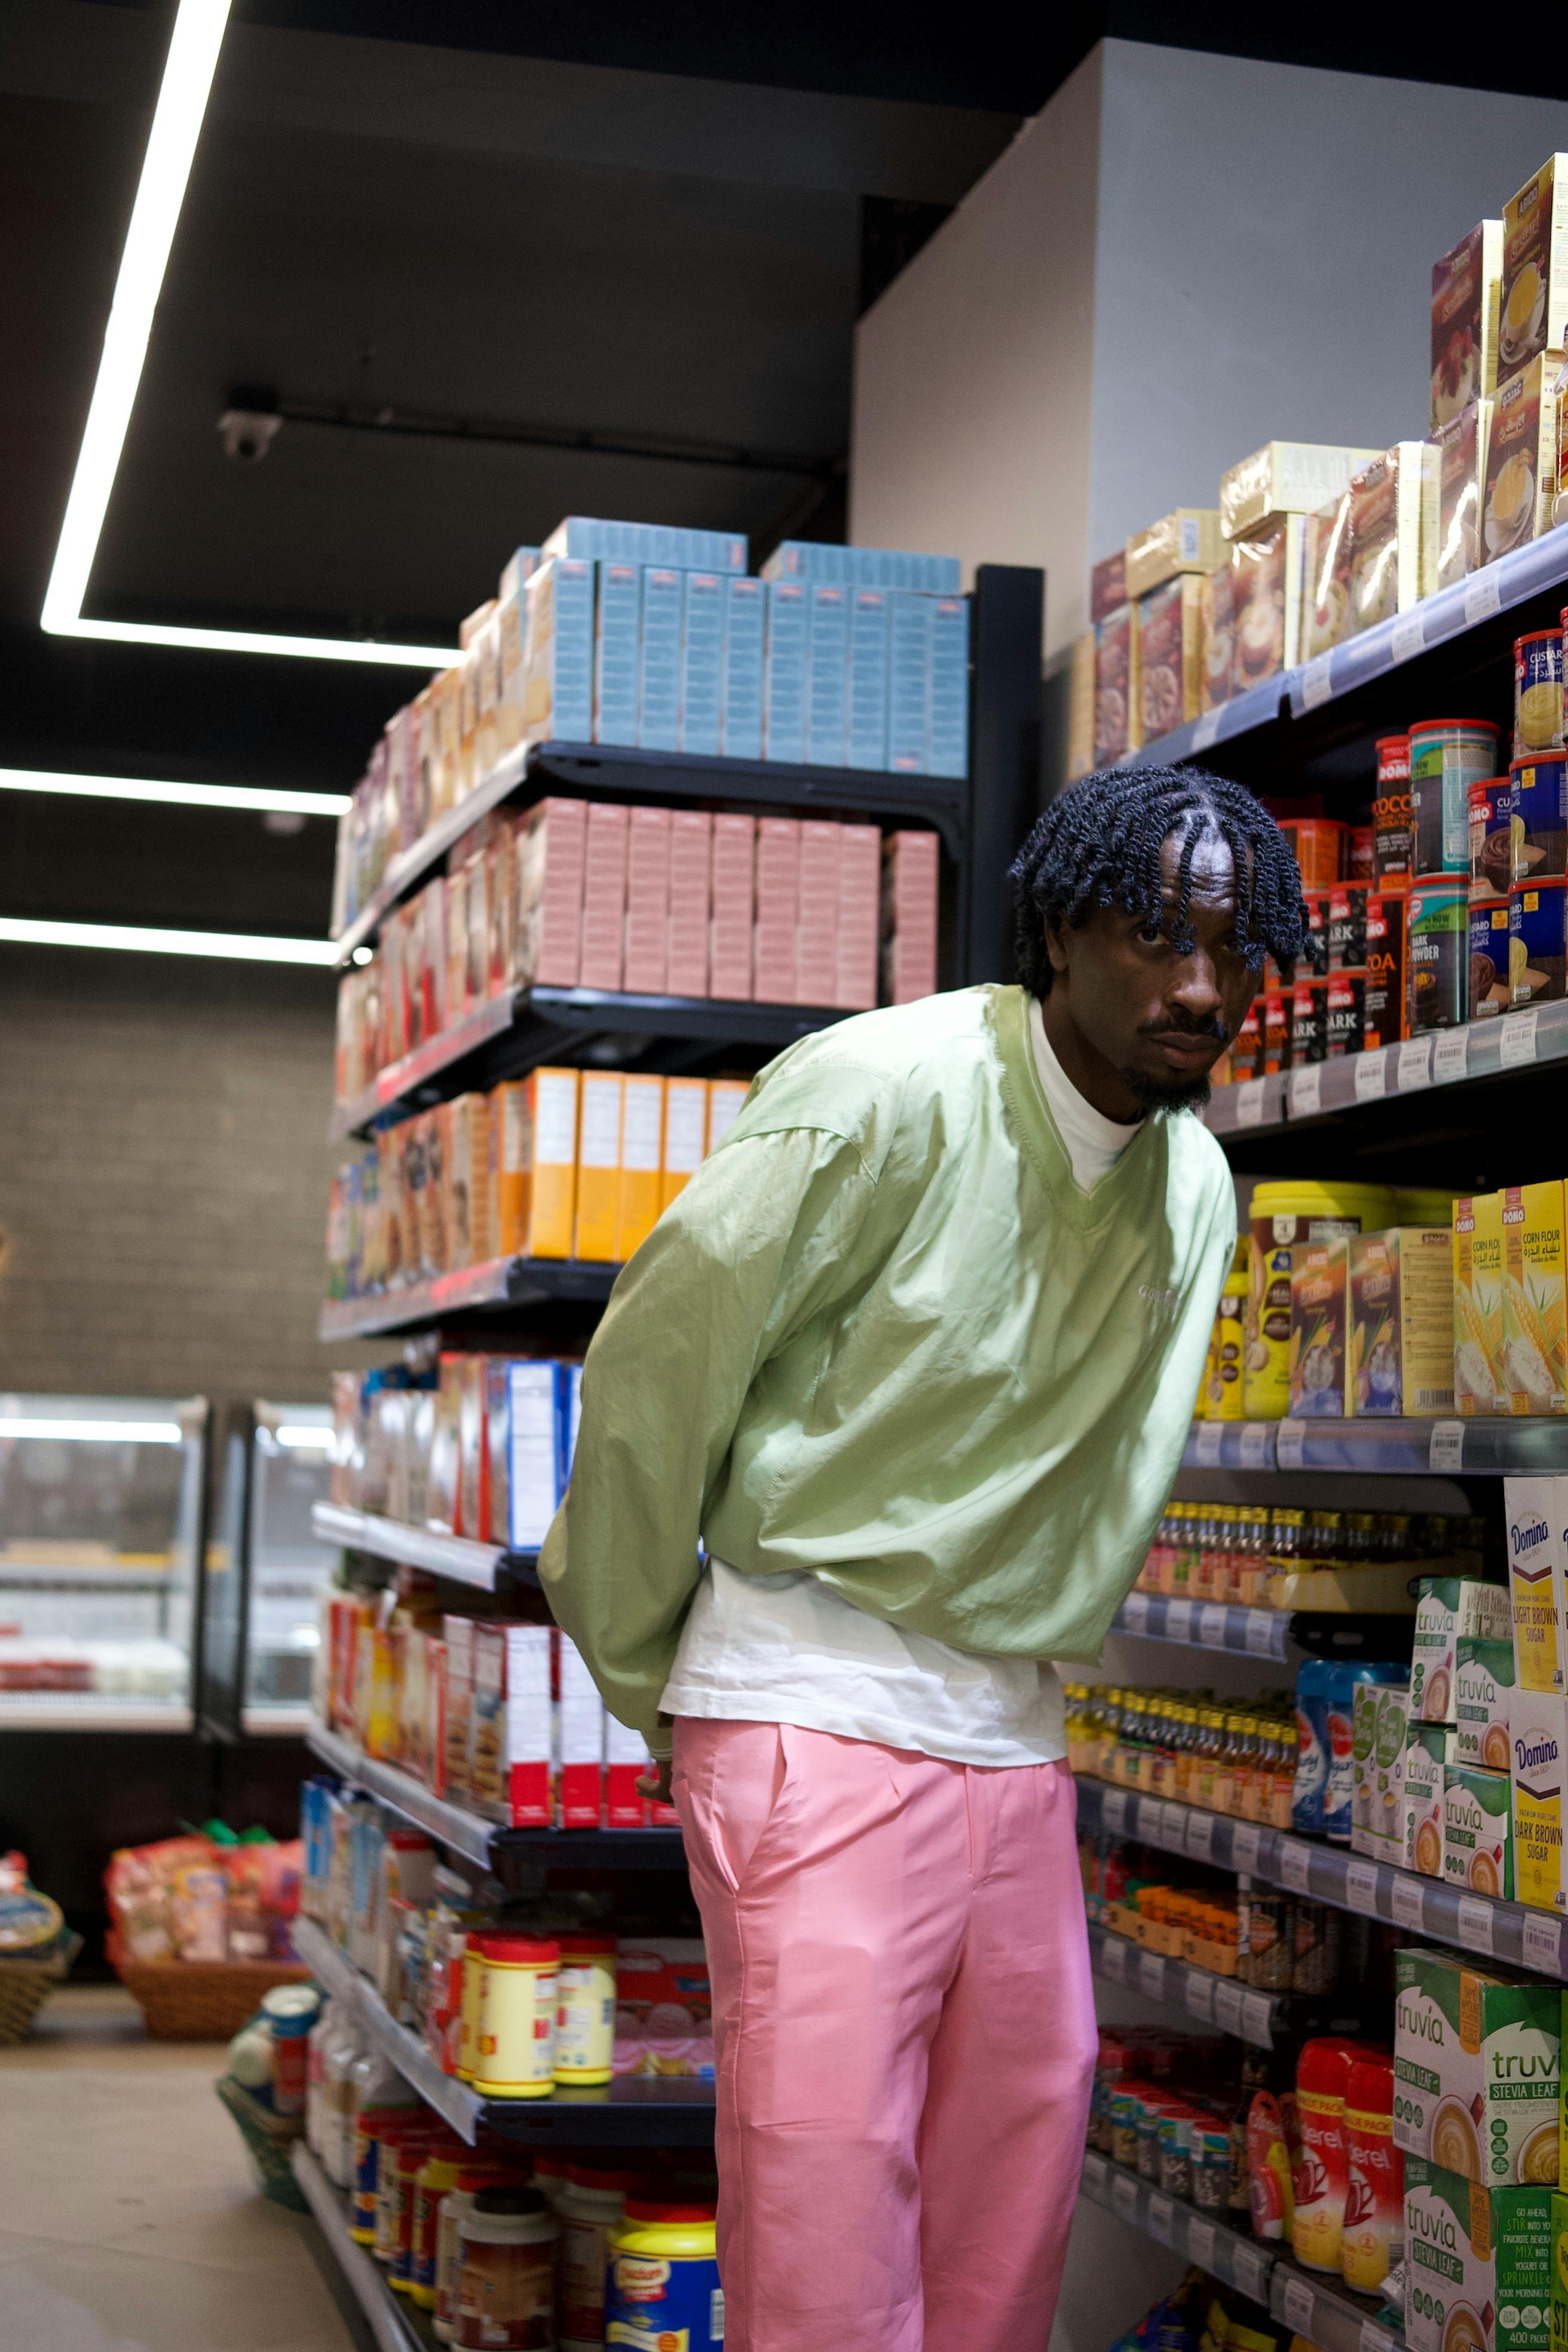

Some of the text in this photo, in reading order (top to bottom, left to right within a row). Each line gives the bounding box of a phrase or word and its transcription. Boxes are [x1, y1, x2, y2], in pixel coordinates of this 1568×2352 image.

[1530, 650, 1563, 663] CUSTAR
[1497, 797, 1510, 807] CU
[1329, 926, 1353, 941] ARK
[1328, 1013, 1357, 1029] ARK
[1293, 1021, 1317, 1037] ARK
[1503, 1210, 1524, 1224] DOMO
[1456, 1219, 1474, 1232] DOMO
[1523, 1230, 1560, 1244] CORN FLOUR
[1473, 1241, 1487, 1252] CORN
[1511, 1521, 1548, 1555] Domino
[1513, 1606, 1558, 1625] LIGHT BROWN
[1526, 1627, 1545, 1643] SUGAR
[1515, 1739, 1558, 1770] Domino
[1520, 1809, 1536, 1818] PREMIUM
[1515, 1820, 1563, 1846] DARK BROWN
[1527, 1843, 1548, 1861] SUGAR
[1493, 2051, 1560, 2078] truv
[1493, 2084, 1557, 2099] STEVIA LEAF
[1364, 2120, 1390, 2132] PACK
[1517, 2208, 1525, 2217] GO
[1507, 2218, 1551, 2231] STIR INTO YO
[1503, 2235, 1551, 2243] FAVORITE BEVERA
[1515, 2244, 1548, 2258] MIX INTO
[1438, 2252, 1456, 2277] LEAF
[1515, 2262, 1548, 2270] YOGURT OR
[1502, 2271, 1544, 2286] SPRINKLE
[1499, 2289, 1514, 2297] YOUR
[1515, 2289, 1542, 2297] MORNING
[1509, 2332, 1549, 2343] 400 PACKET
